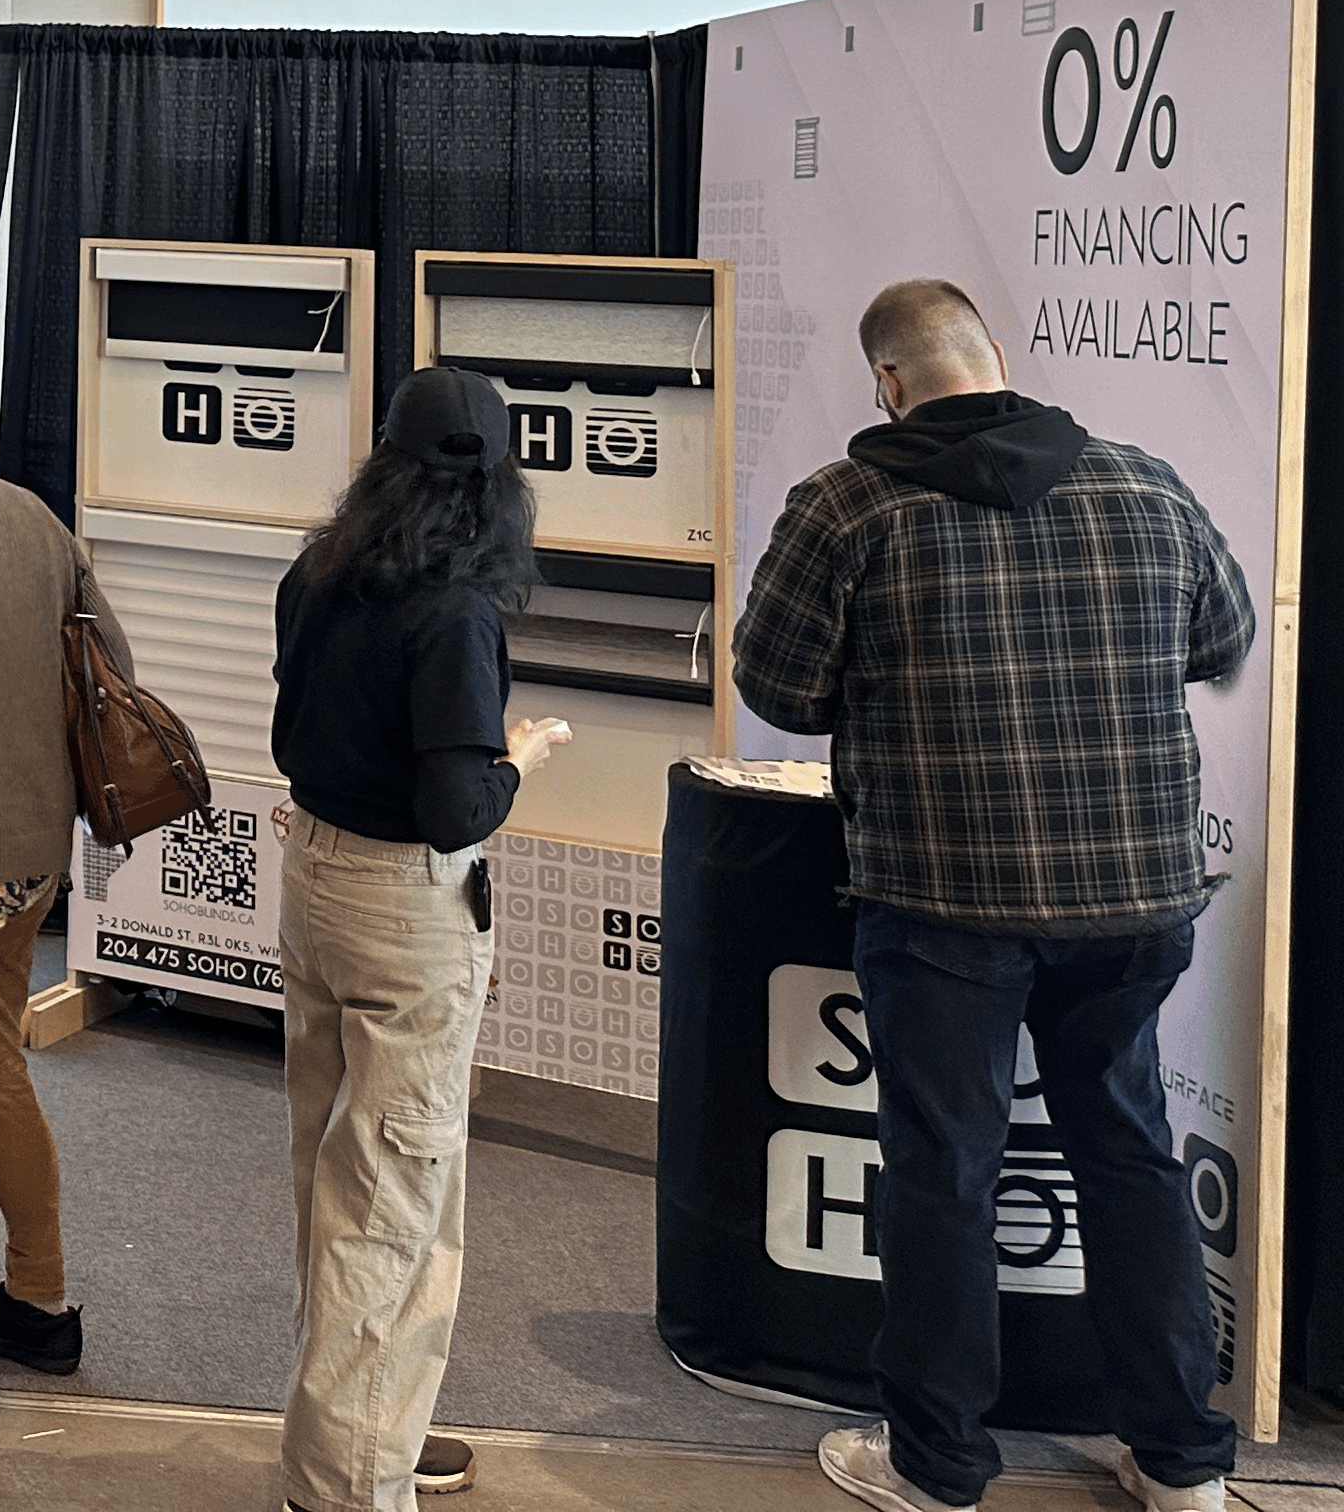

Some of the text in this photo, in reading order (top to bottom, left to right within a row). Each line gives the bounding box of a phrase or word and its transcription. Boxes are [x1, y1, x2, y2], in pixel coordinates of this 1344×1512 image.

[1043, 10, 1176, 175] 0%
[1034, 202, 1248, 266] FINANCING
[1030, 297, 1230, 366] AVAILABLE
[97, 914, 118, 929] 3-2
[121, 918, 174, 938] DONALD
[198, 933, 221, 948] R3L
[163, 899, 255, 926] SOHOBLINDS.CA
[102, 937, 139, 960] 204
[144, 946, 180, 968] 475
[187, 953, 247, 981] SOHO
[1163, 1064, 1235, 1124] URFACE
